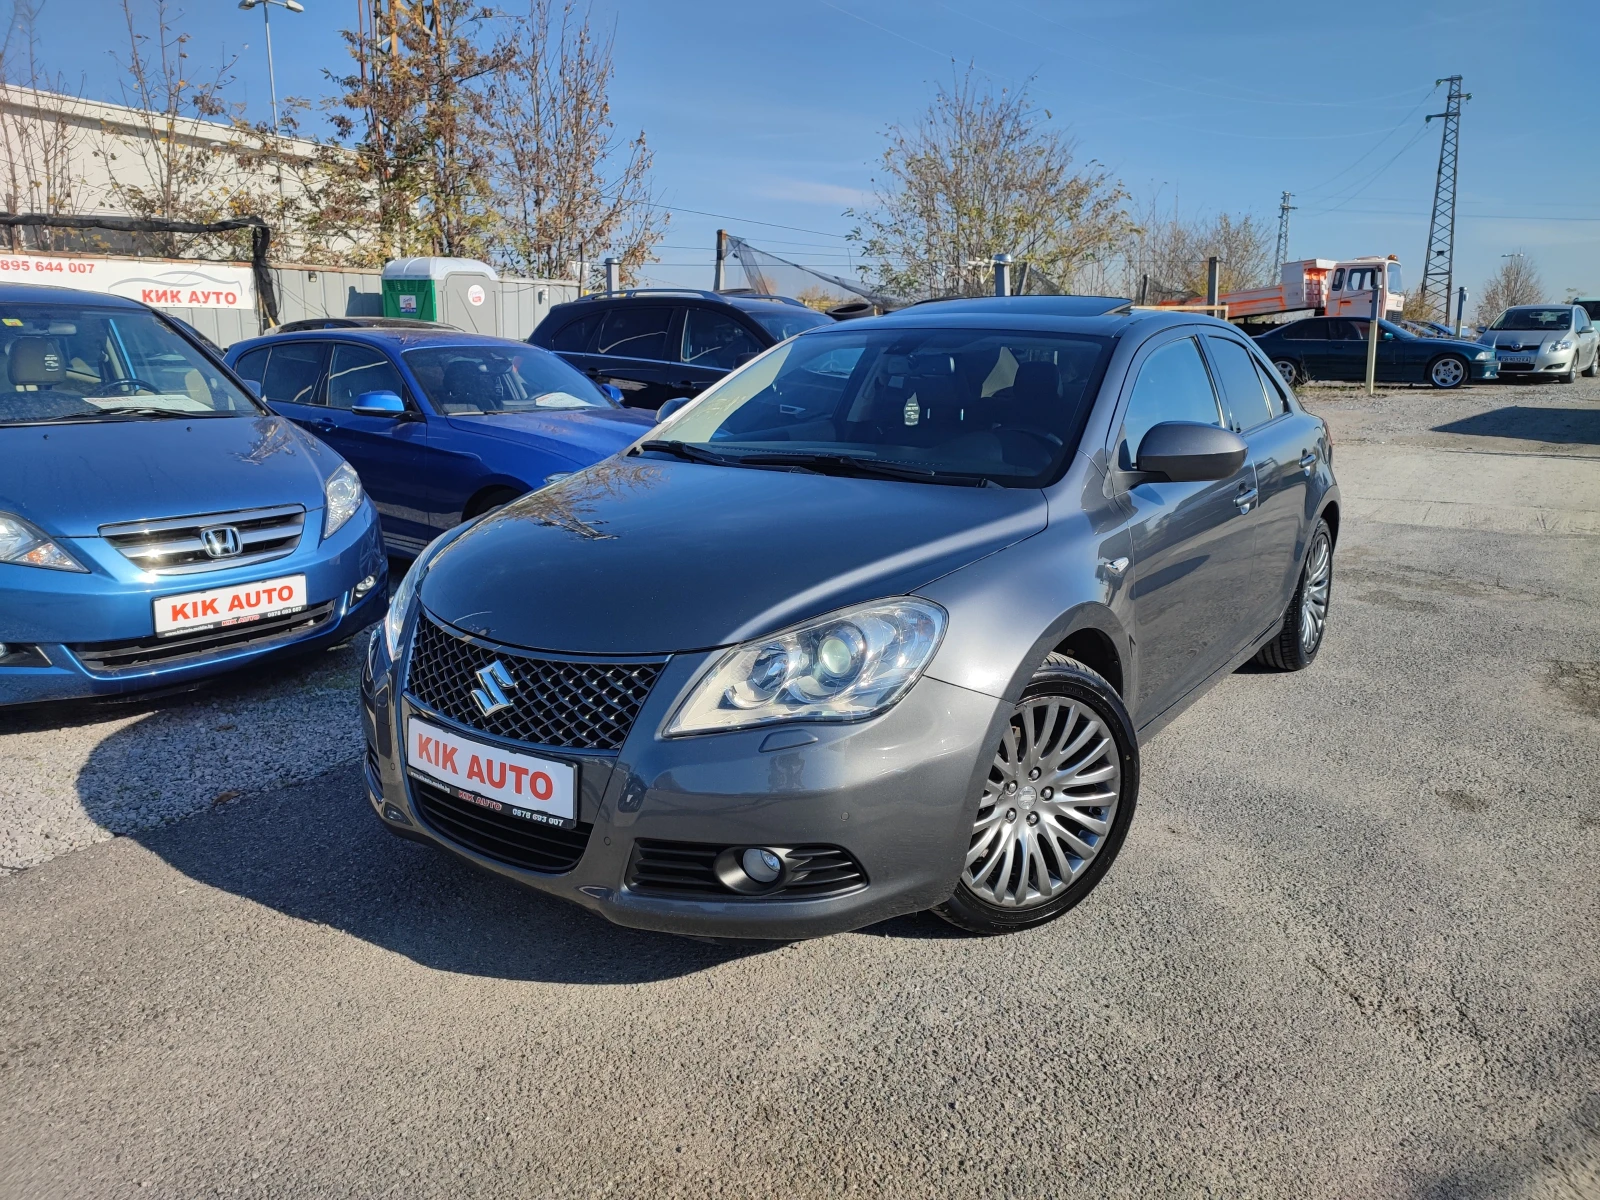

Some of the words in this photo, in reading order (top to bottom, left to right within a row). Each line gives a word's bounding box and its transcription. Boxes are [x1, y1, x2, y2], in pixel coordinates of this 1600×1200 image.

[0, 259, 30, 271] 895
[35, 261, 64, 273] 644
[68, 262, 95, 274] 007
[141, 289, 183, 304] КИК
[187, 290, 238, 305] АУТО
[171, 597, 220, 622] KIK
[227, 585, 294, 612] AUTO
[418, 732, 459, 775] KIK
[466, 754, 554, 801] AUTO
[458, 789, 475, 803] KIK
[475, 796, 502, 811] AUTO
[548, 816, 564, 827] 007
